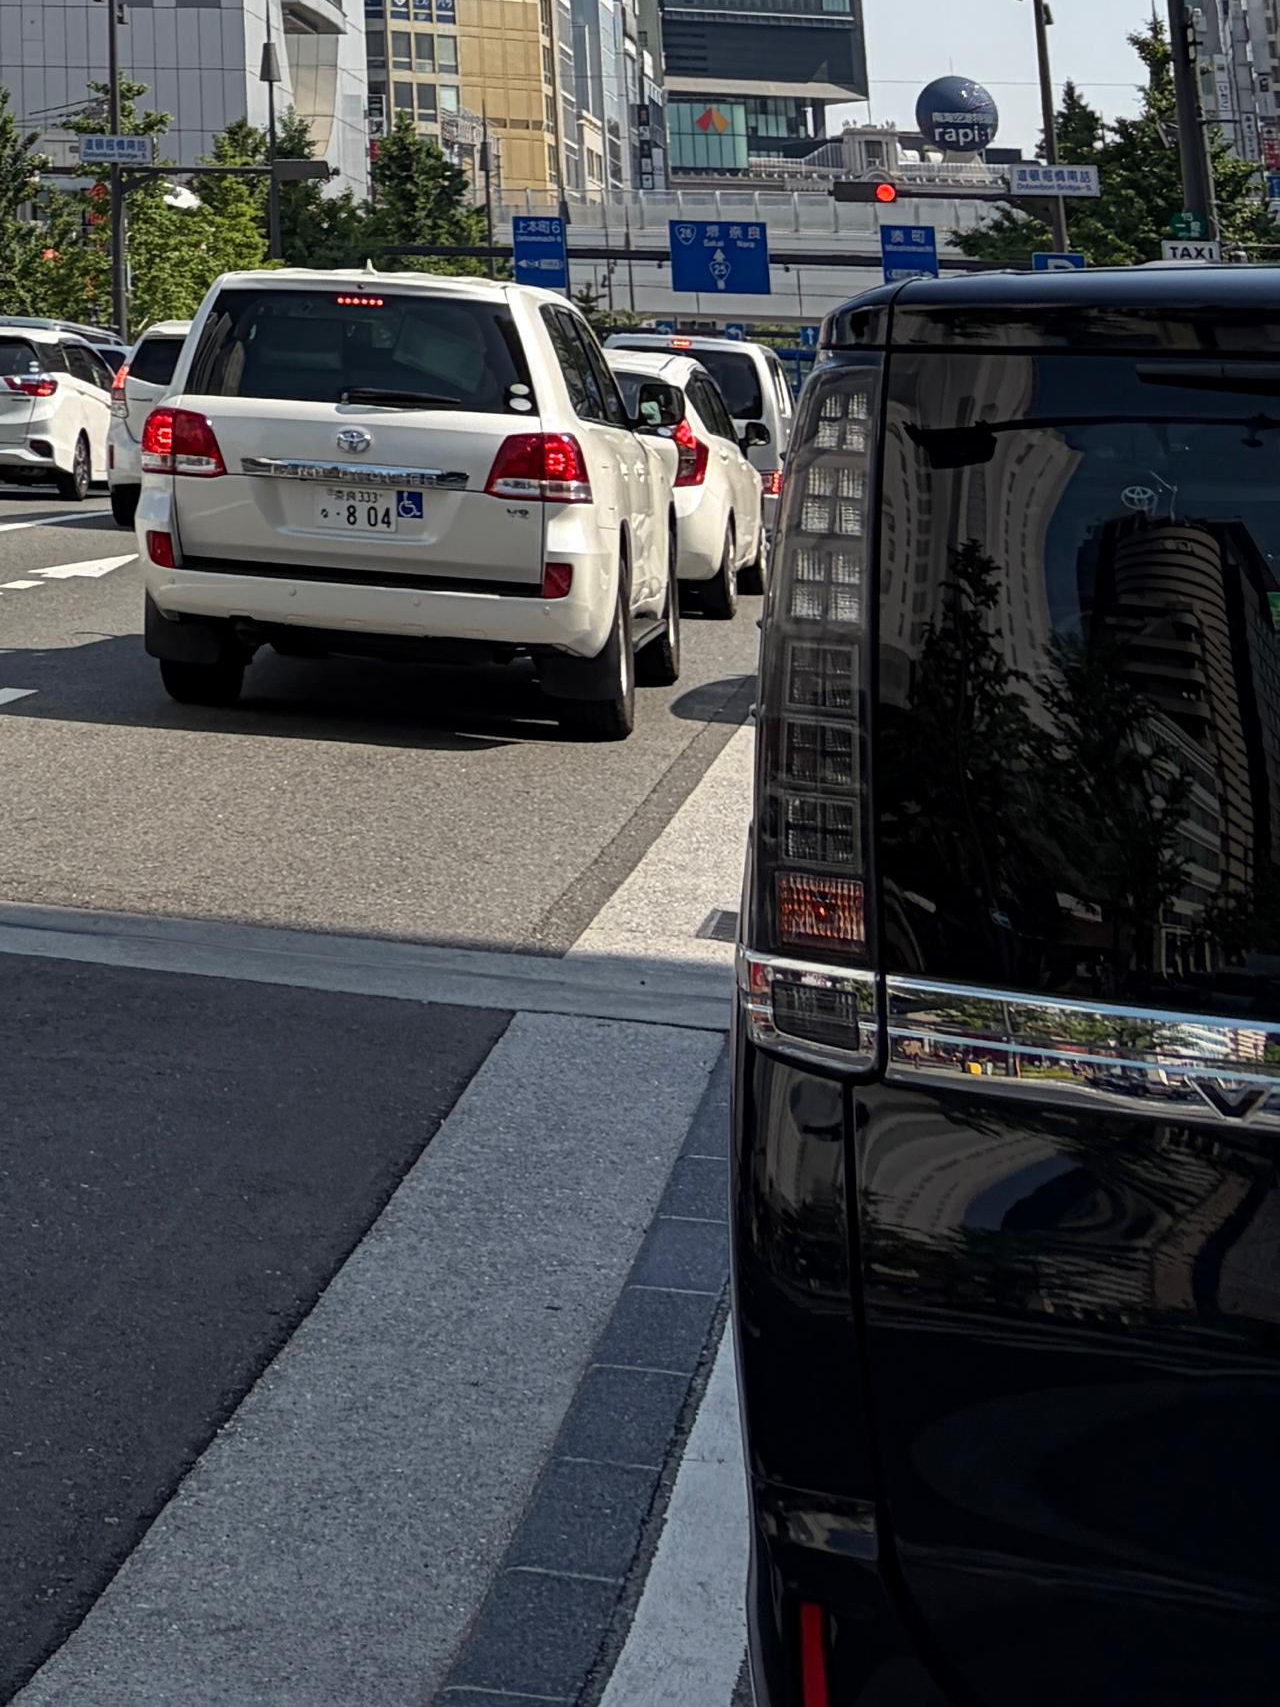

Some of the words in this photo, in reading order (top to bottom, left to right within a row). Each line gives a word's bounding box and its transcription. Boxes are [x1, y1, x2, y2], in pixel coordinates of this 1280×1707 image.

[516, 220, 560, 234] 上本町6
[1169, 247, 1214, 260] TAXI
